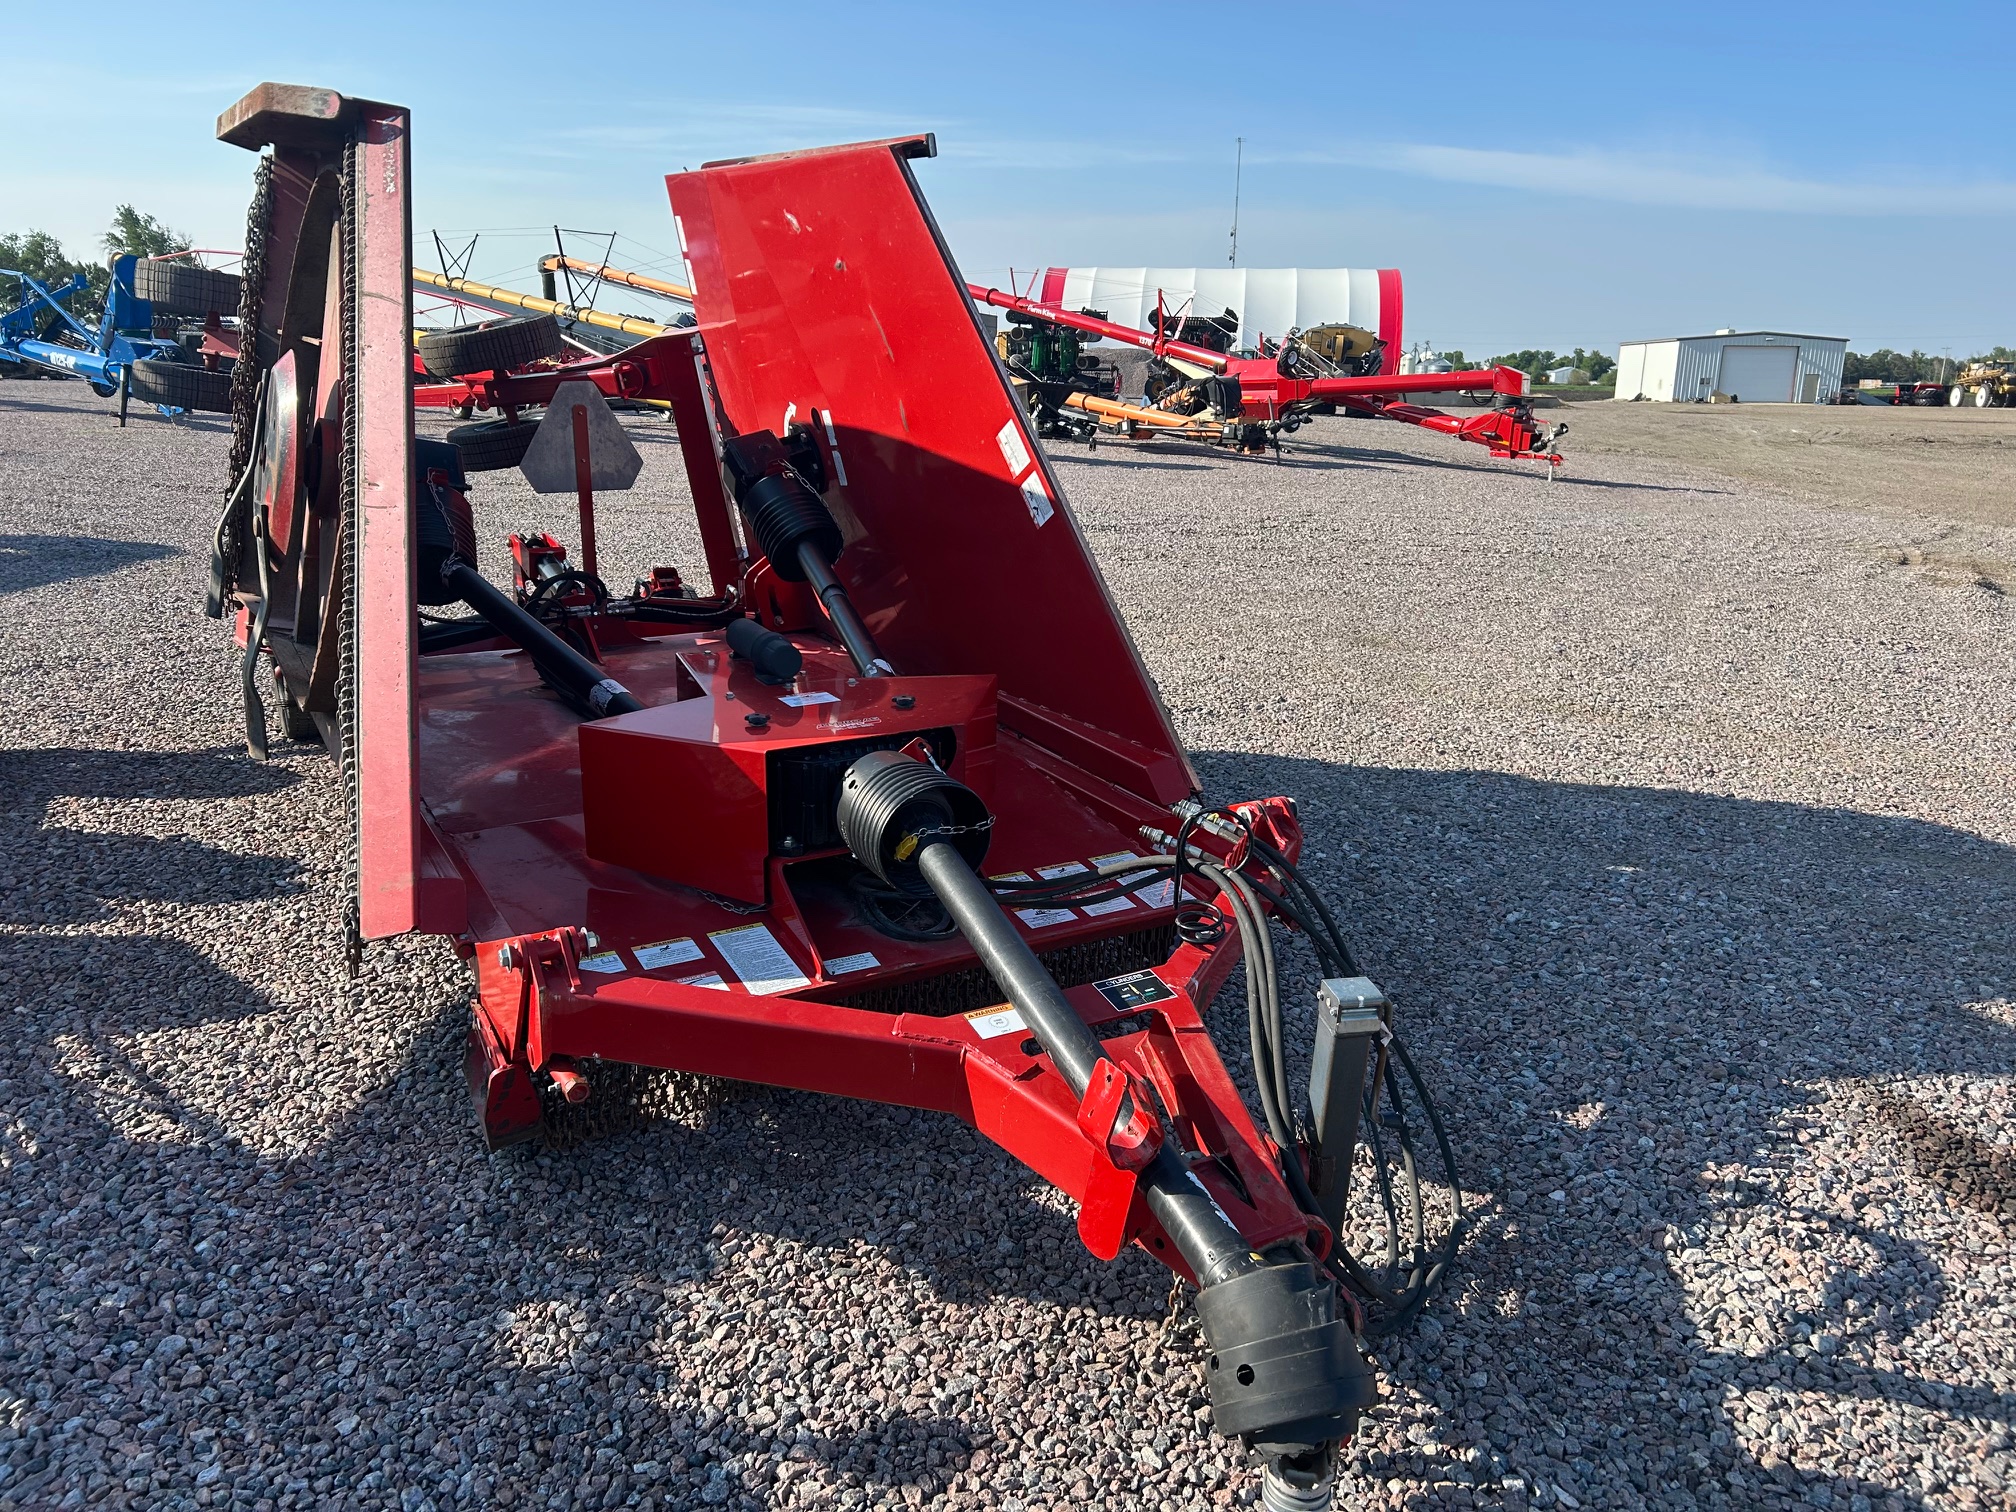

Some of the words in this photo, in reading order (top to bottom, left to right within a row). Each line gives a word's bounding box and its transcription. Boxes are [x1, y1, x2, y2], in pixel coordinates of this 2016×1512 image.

[1027, 304, 1042, 314] Farm
[1042, 308, 1056, 319] King
[725, 924, 754, 933] CAUTION
[651, 938, 684, 948] WARNING
[830, 954, 866, 964] ATTENTION
[676, 973, 707, 983] DANGER
[1105, 973, 1144, 986] CYLINDERS
[974, 1005, 1009, 1017] WARNING
